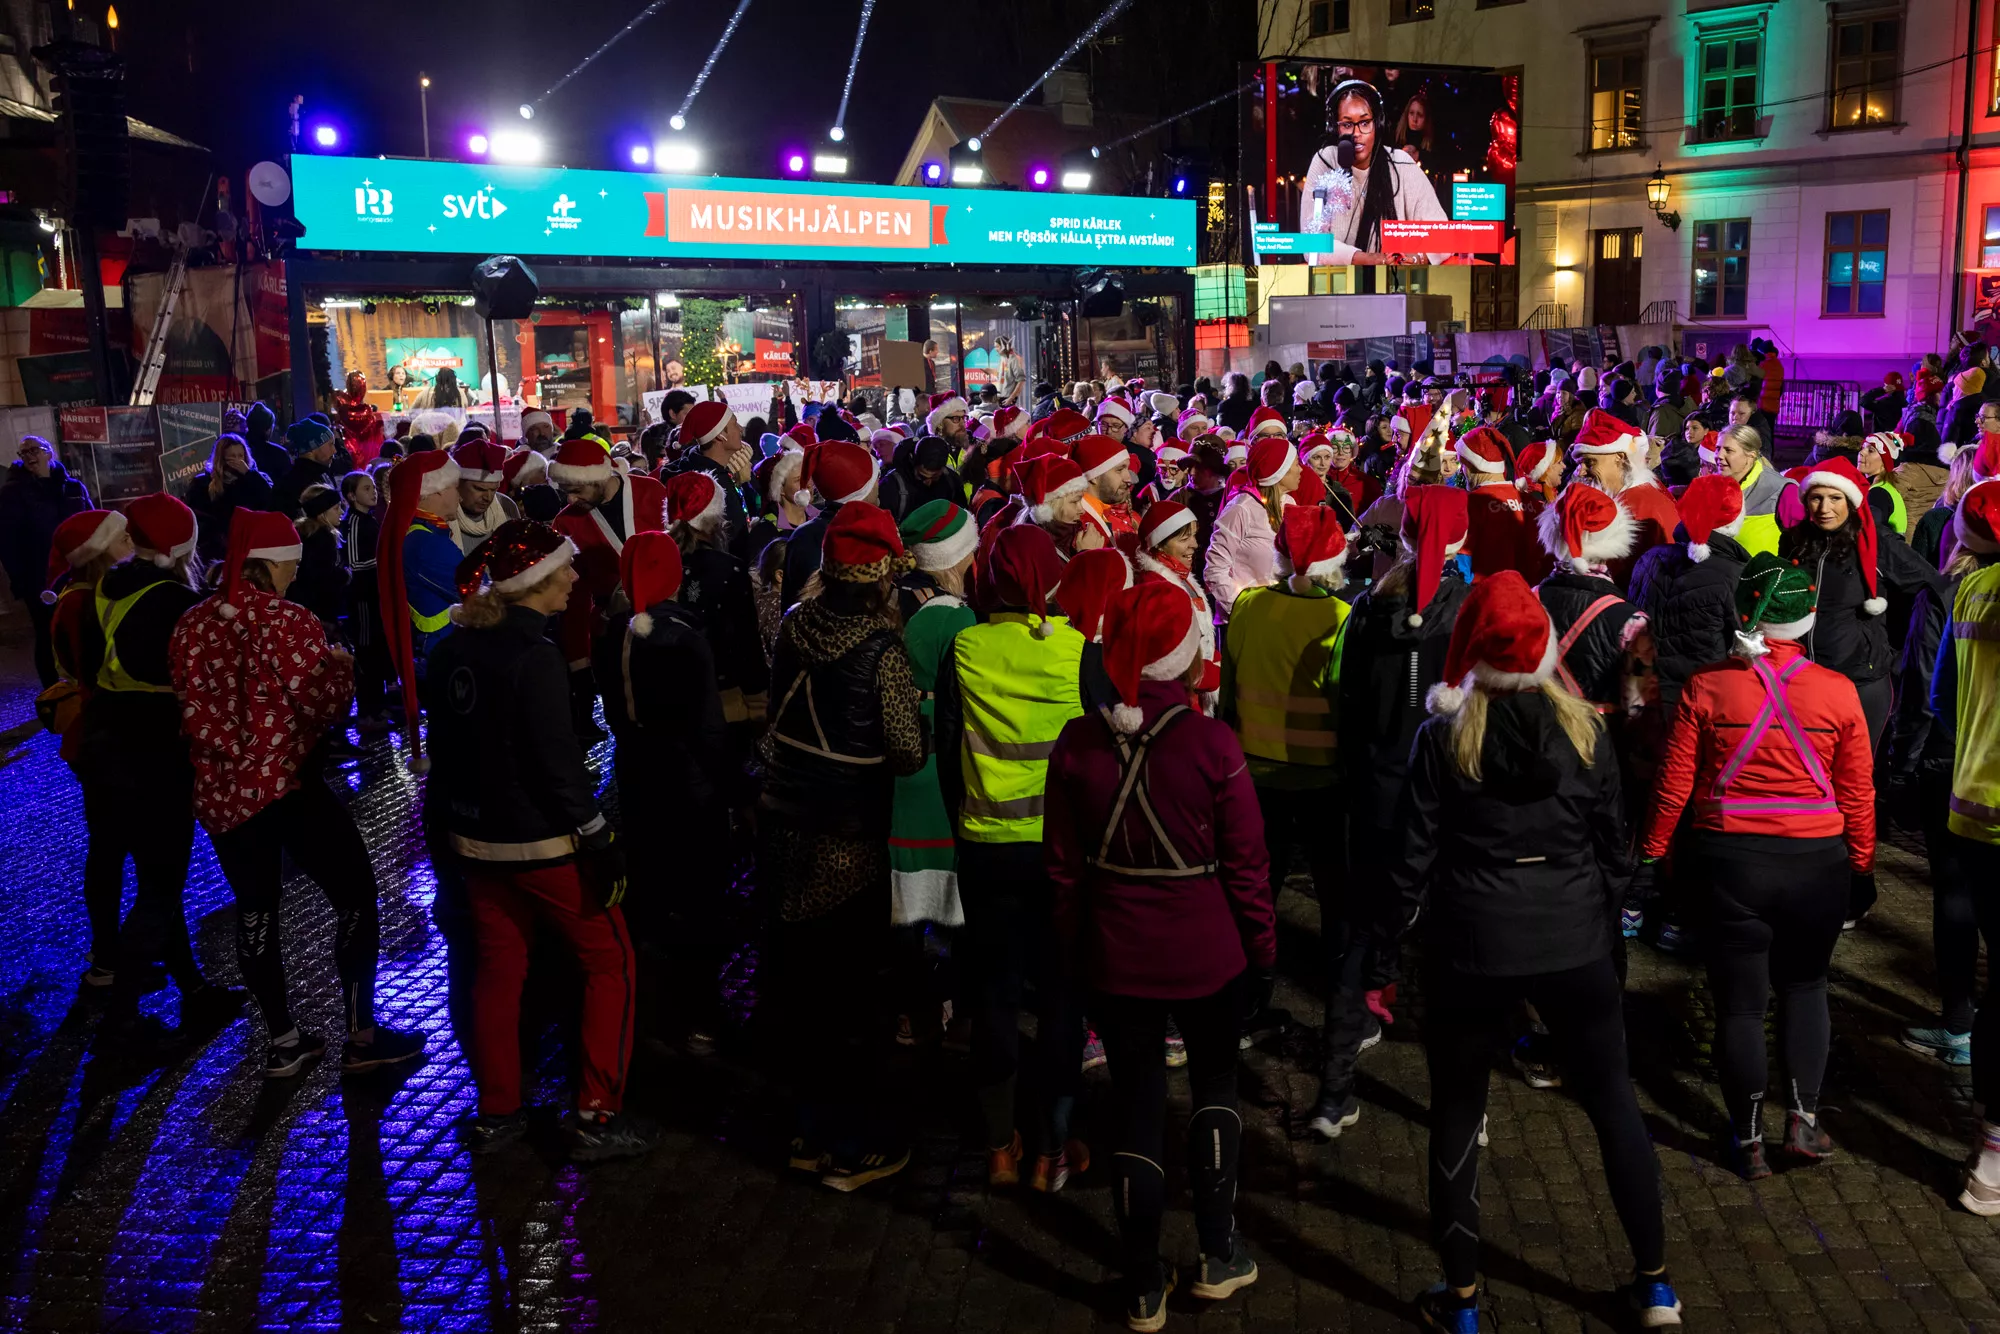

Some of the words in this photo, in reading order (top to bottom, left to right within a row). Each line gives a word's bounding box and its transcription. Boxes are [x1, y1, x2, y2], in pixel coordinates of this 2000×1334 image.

[355, 187, 394, 215] P3
[443, 190, 491, 220] svt
[690, 203, 912, 236] MUSIKHJÄLPEN
[1049, 217, 1081, 228] SPRID
[1083, 216, 1122, 231] KÄRLEK
[988, 230, 1012, 242] MEN
[1016, 229, 1058, 244] FÖRSÖK
[1060, 230, 1093, 245] HÅLLA
[1094, 233, 1127, 246] EXTRA
[1128, 232, 1175, 247] AVSTÅND!
[180, 408, 220, 424] DECEMBER
